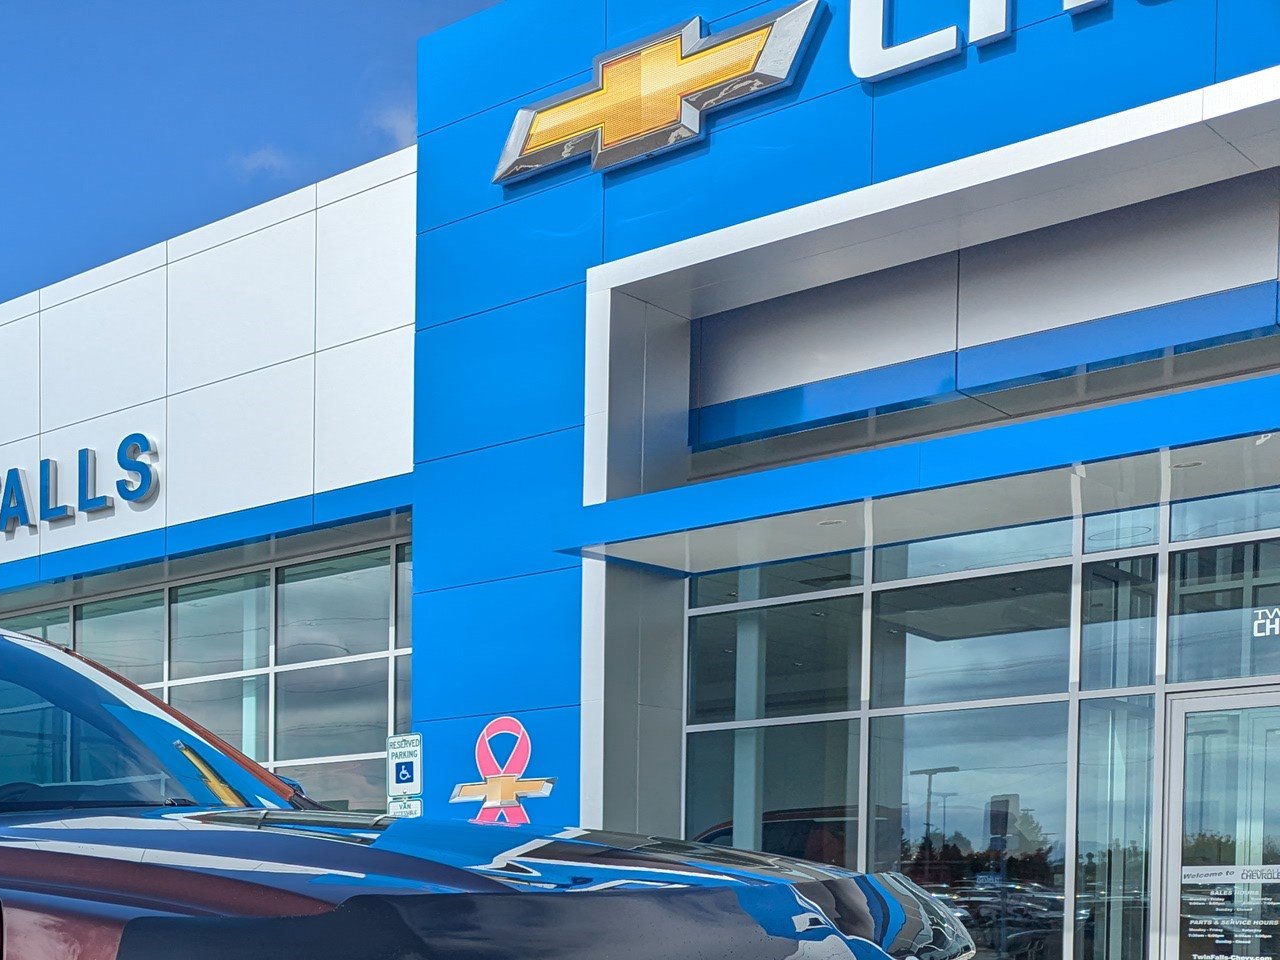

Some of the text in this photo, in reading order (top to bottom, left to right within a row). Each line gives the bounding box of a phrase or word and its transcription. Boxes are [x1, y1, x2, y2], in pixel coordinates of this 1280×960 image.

[389, 738, 420, 750] RESERVED
[390, 750, 418, 761] PARKING
[1183, 871, 1223, 880] Welcome
